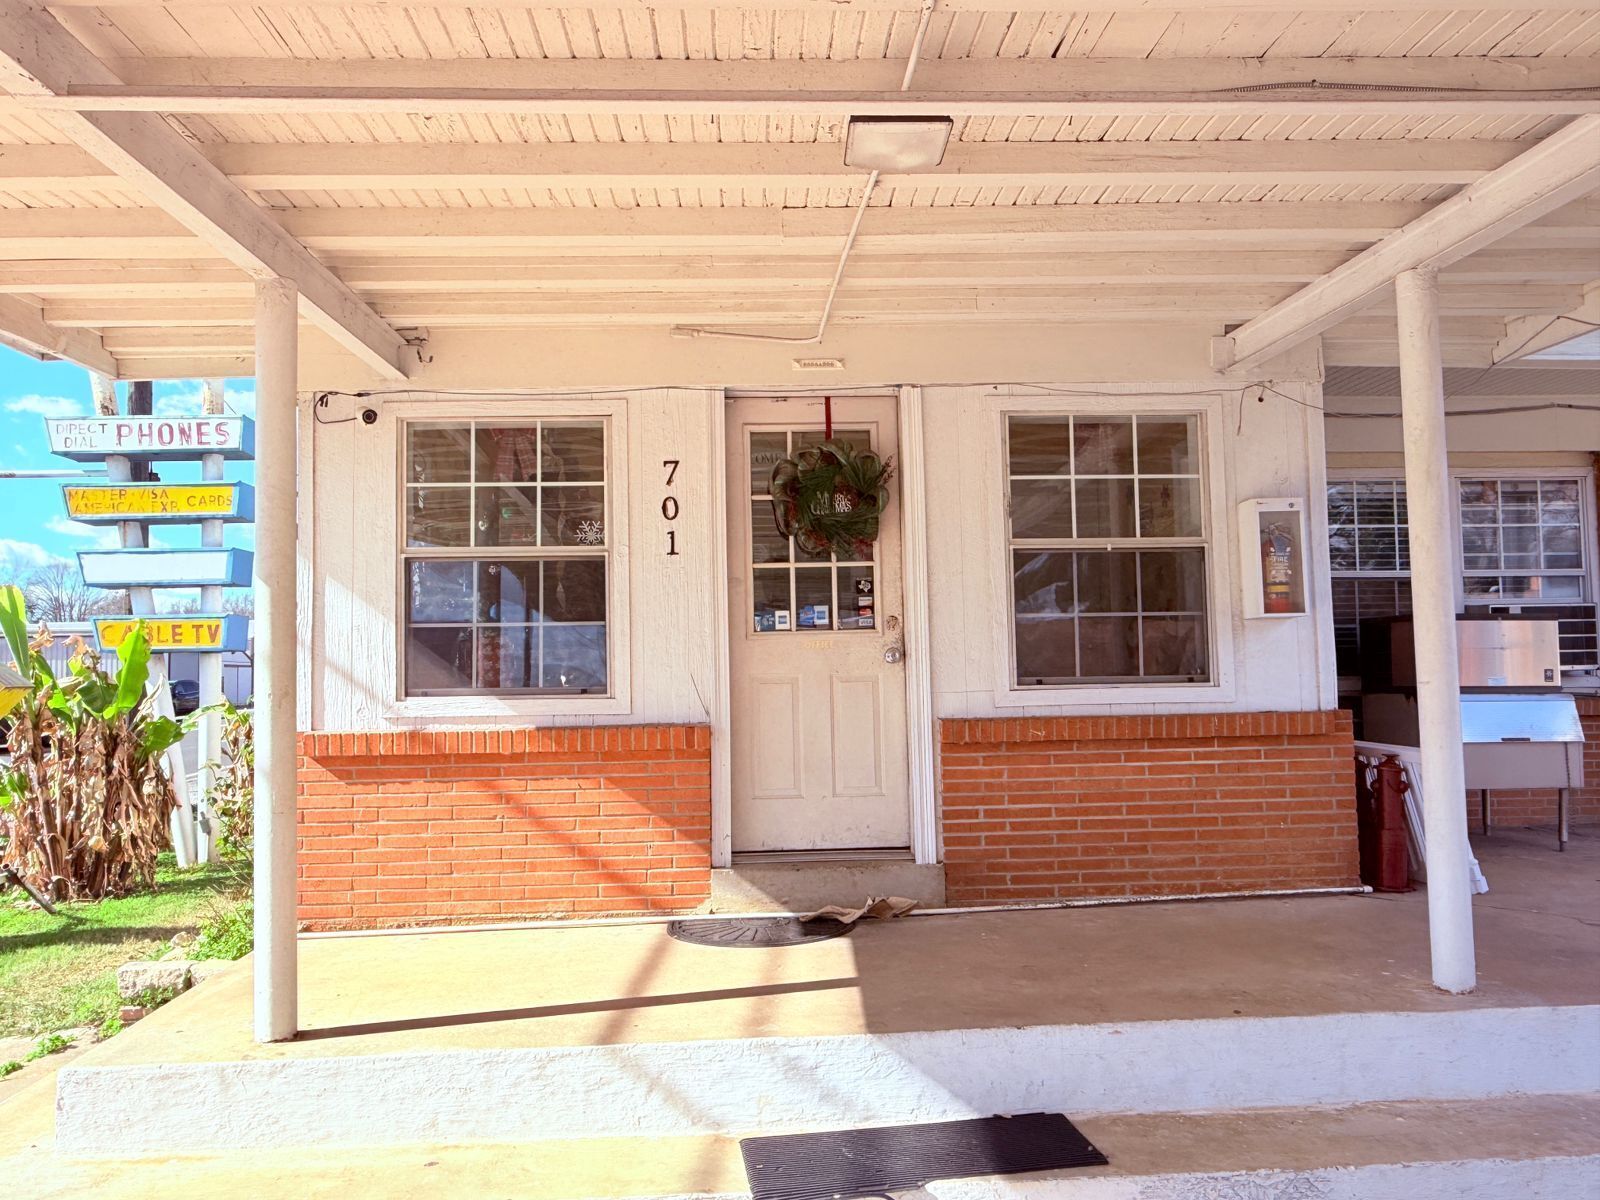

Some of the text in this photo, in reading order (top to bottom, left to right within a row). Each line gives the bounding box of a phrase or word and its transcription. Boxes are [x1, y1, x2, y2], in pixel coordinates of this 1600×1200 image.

[56, 423, 108, 435] DIRECT
[116, 422, 230, 447] PHONES
[64, 436, 97, 448] DIAL
[68, 489, 169, 501] MASTER VISA
[187, 494, 233, 507] CARDS
[661, 460, 680, 556] 701
[192, 624, 220, 643] TV
